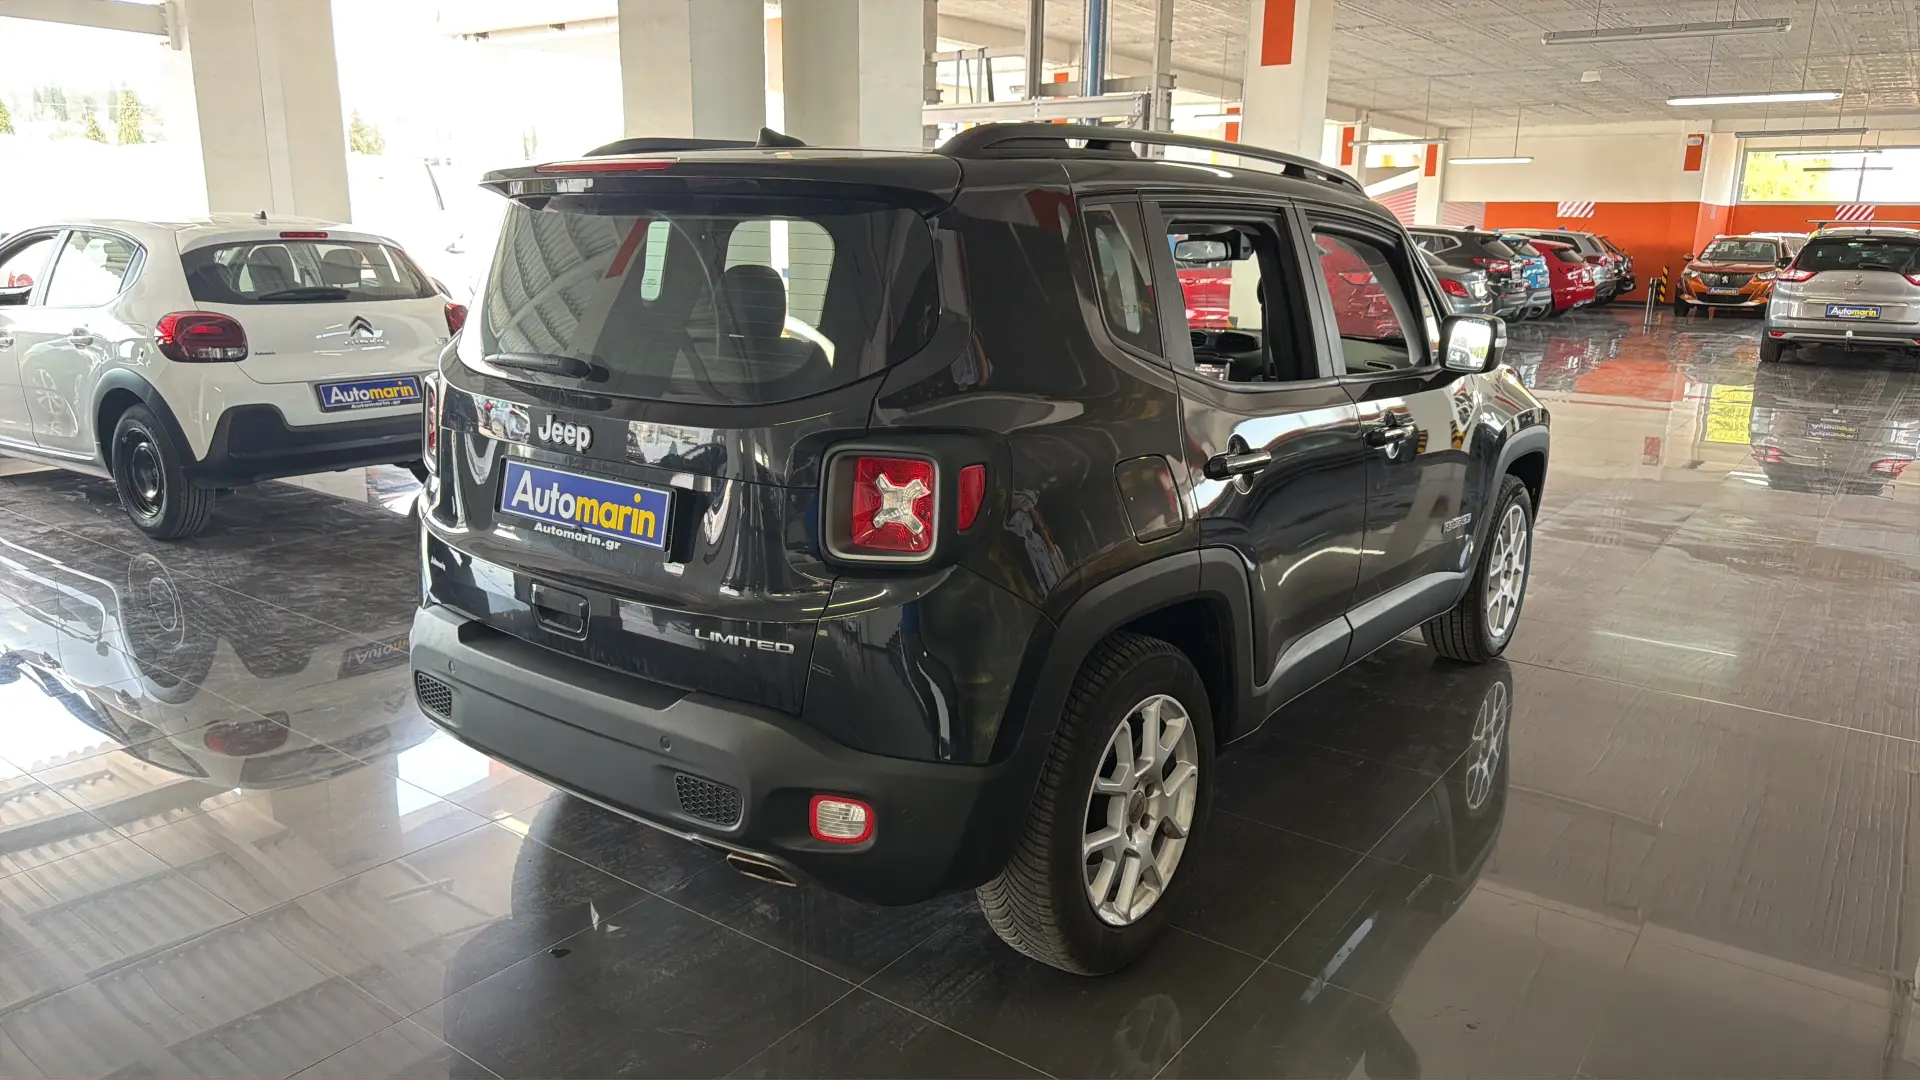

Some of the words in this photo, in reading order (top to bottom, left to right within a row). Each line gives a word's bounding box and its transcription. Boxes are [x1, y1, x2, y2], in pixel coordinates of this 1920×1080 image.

[1830, 305, 1877, 317] Automarin
[330, 381, 415, 404] Automarin
[351, 400, 401, 409] Automarin.gr
[538, 413, 593, 453] Jeep
[511, 470, 657, 539] Automarin
[534, 521, 622, 550] Automarin.gr
[694, 628, 795, 655] LIMITED
